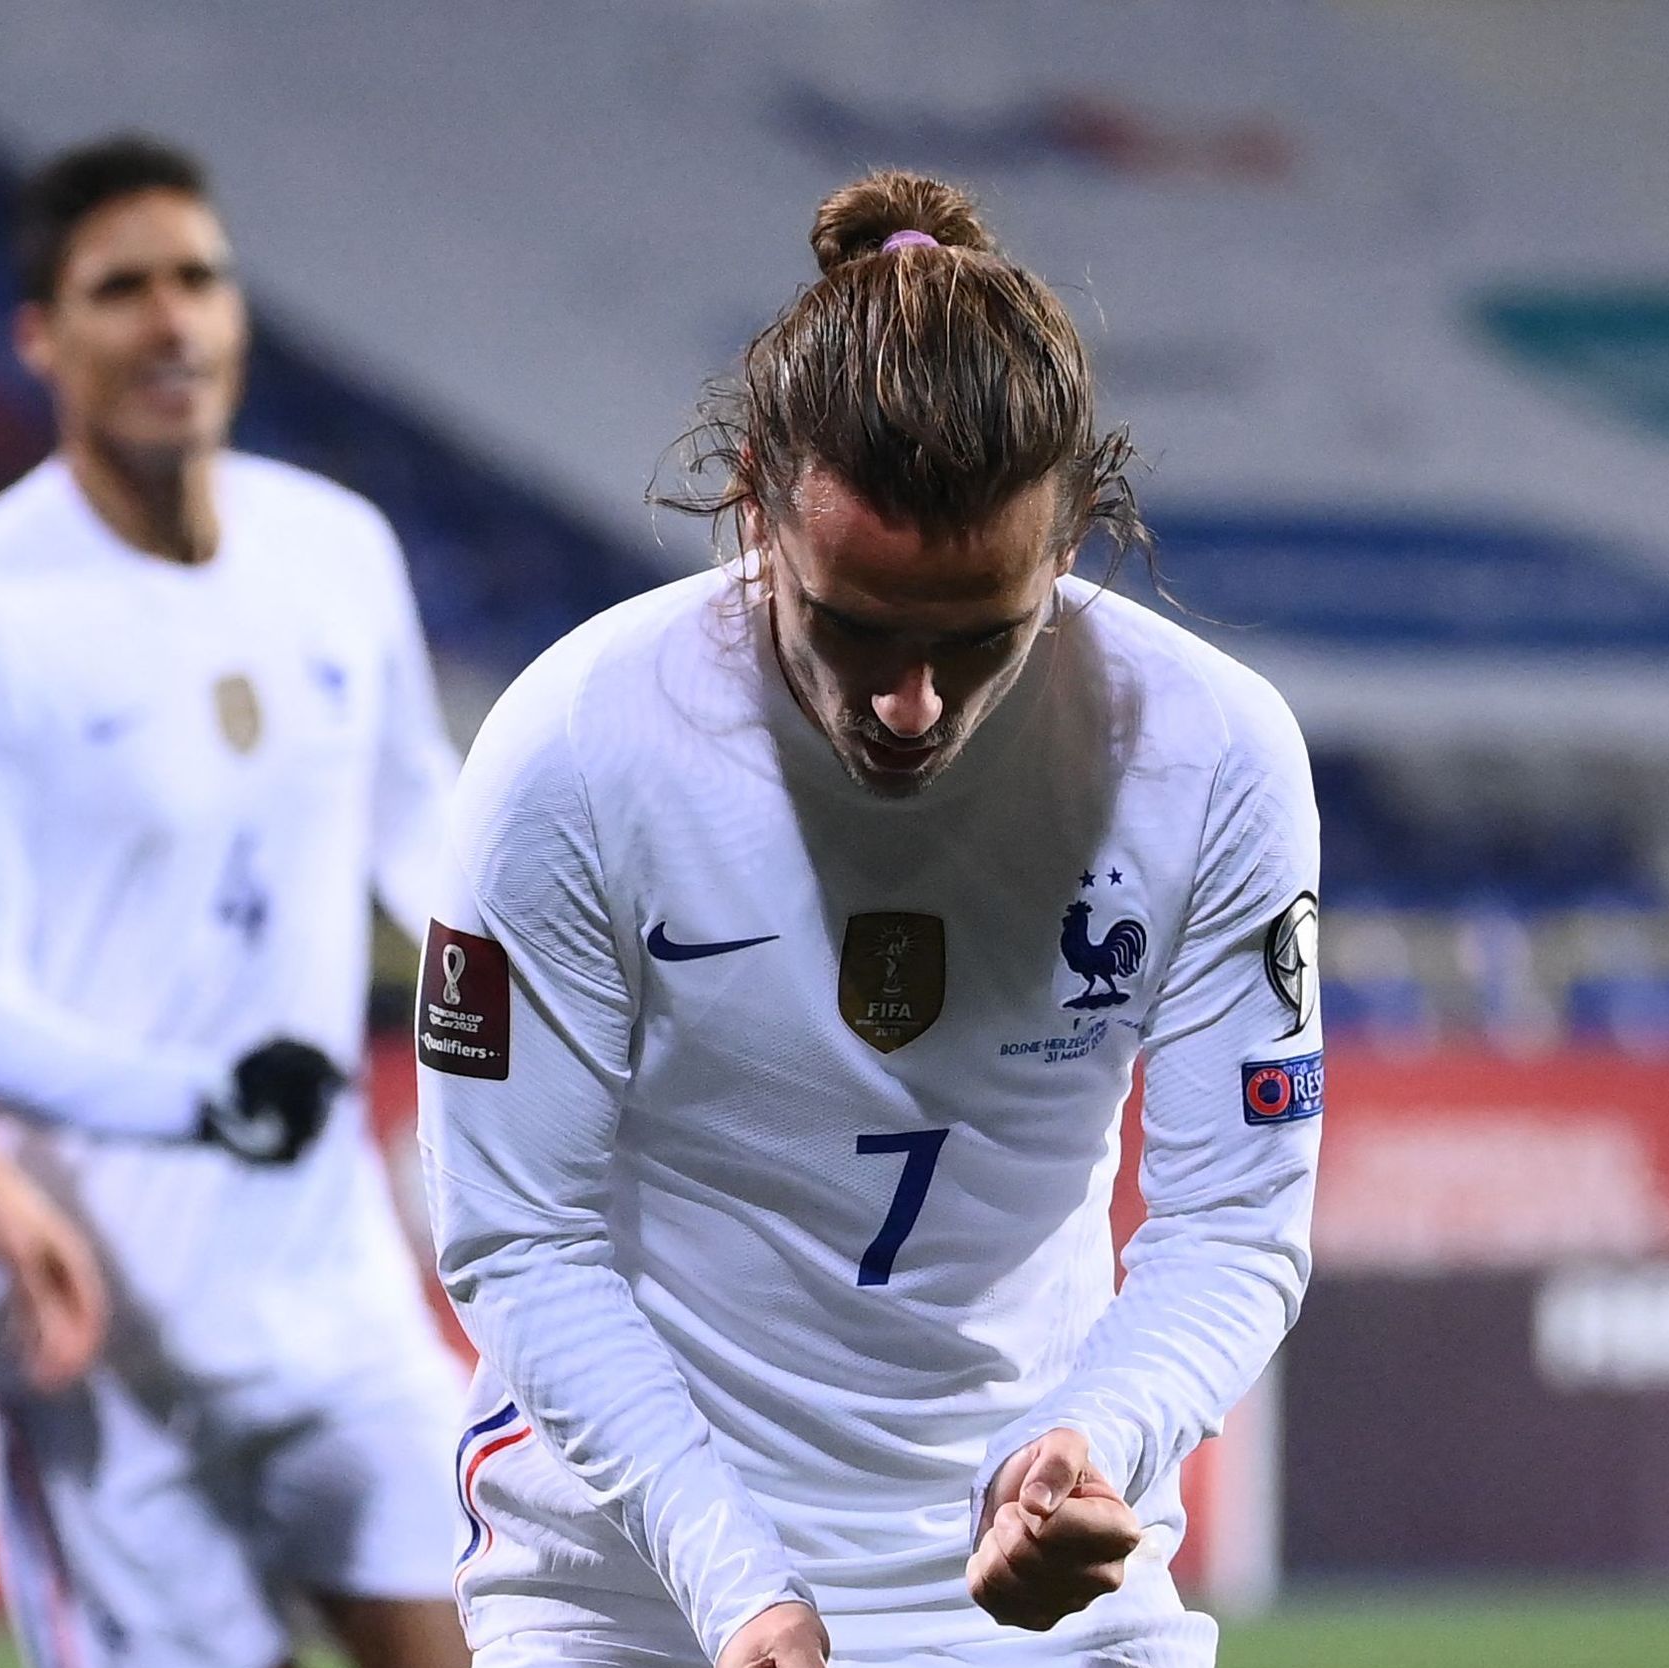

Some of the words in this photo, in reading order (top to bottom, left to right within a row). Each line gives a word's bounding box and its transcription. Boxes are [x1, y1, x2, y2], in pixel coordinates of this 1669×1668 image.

[867, 1002, 911, 1019] FIFA
[424, 1032, 487, 1059] Qualifiers
[1044, 1051, 1058, 1063] 31
[856, 1128, 950, 1286] 7
